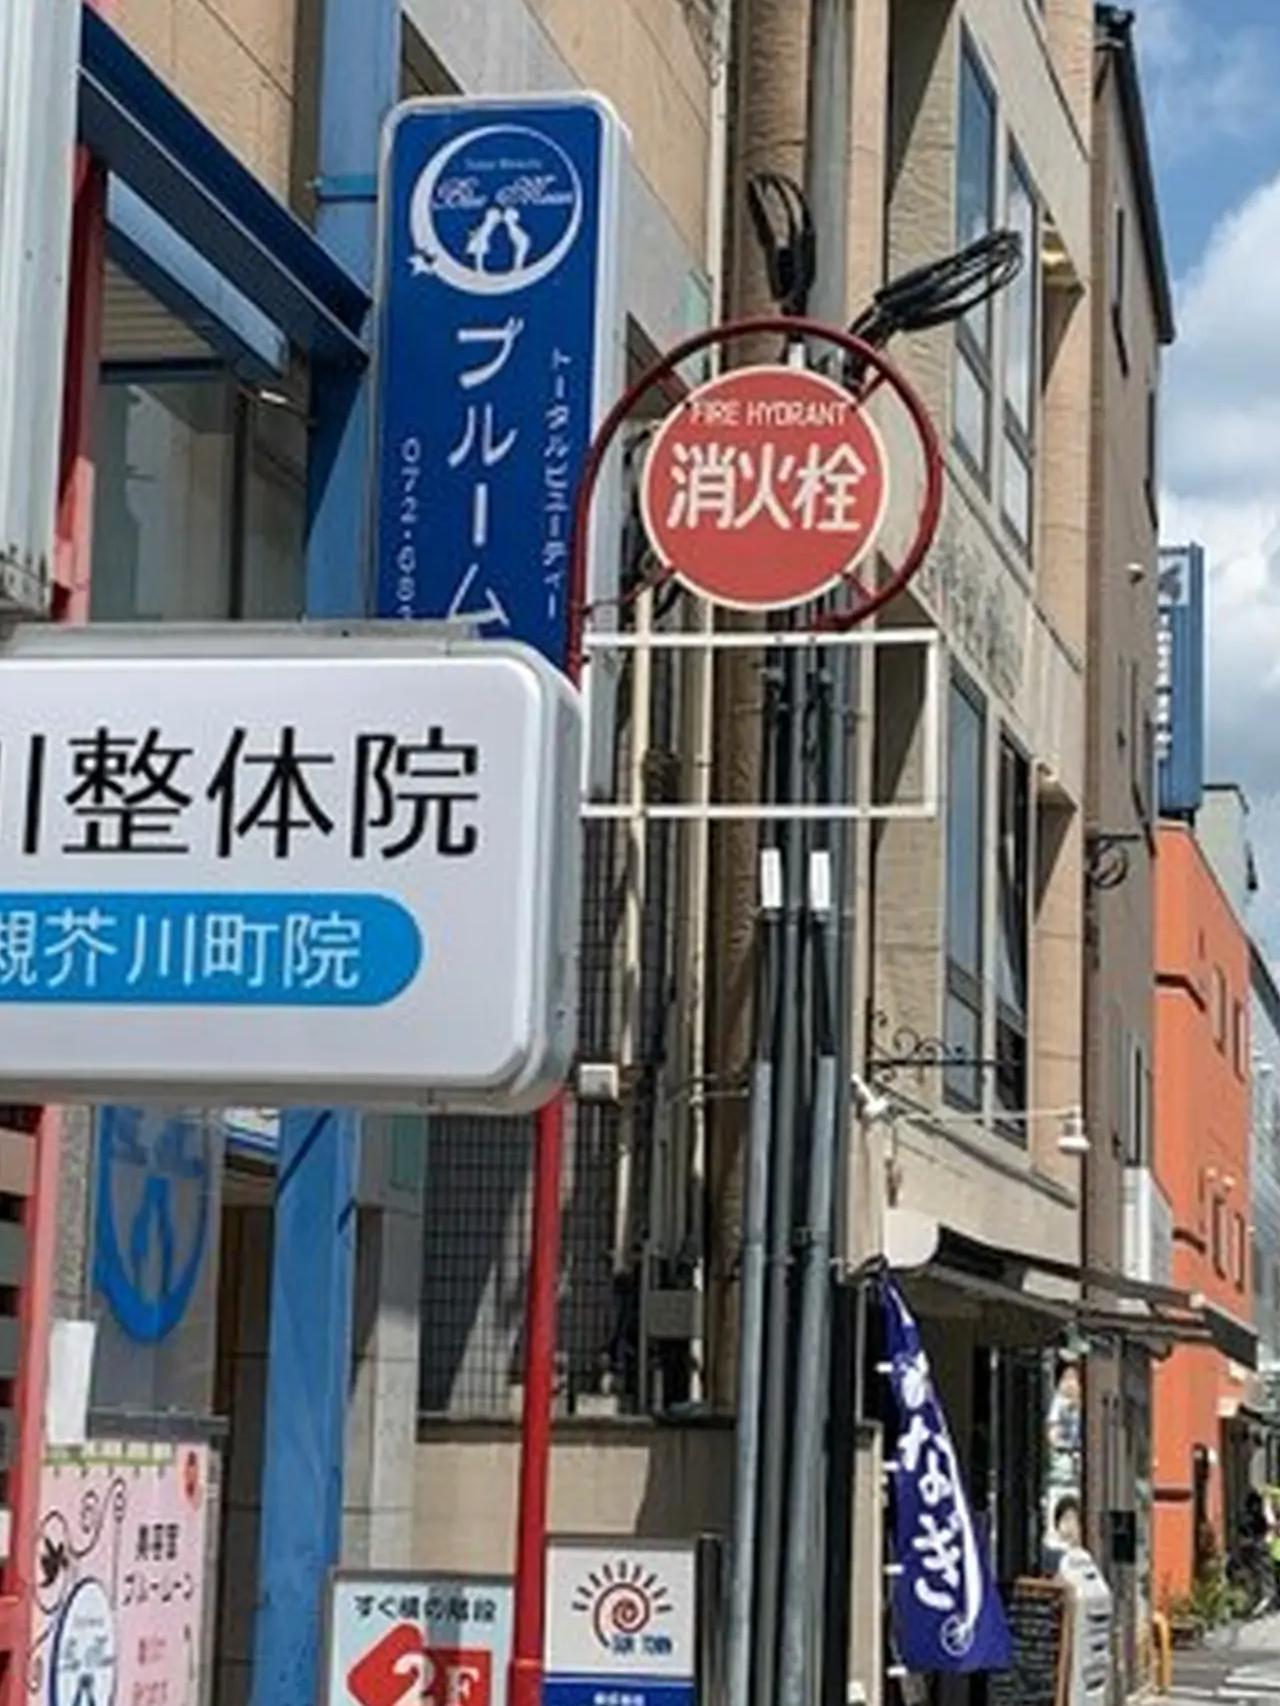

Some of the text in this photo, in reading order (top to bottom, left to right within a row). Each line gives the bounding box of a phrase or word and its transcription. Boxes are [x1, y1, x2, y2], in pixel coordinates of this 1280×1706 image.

[691, 401, 847, 426] FIRE HYDRANT
[666, 440, 868, 533] 消火栓
